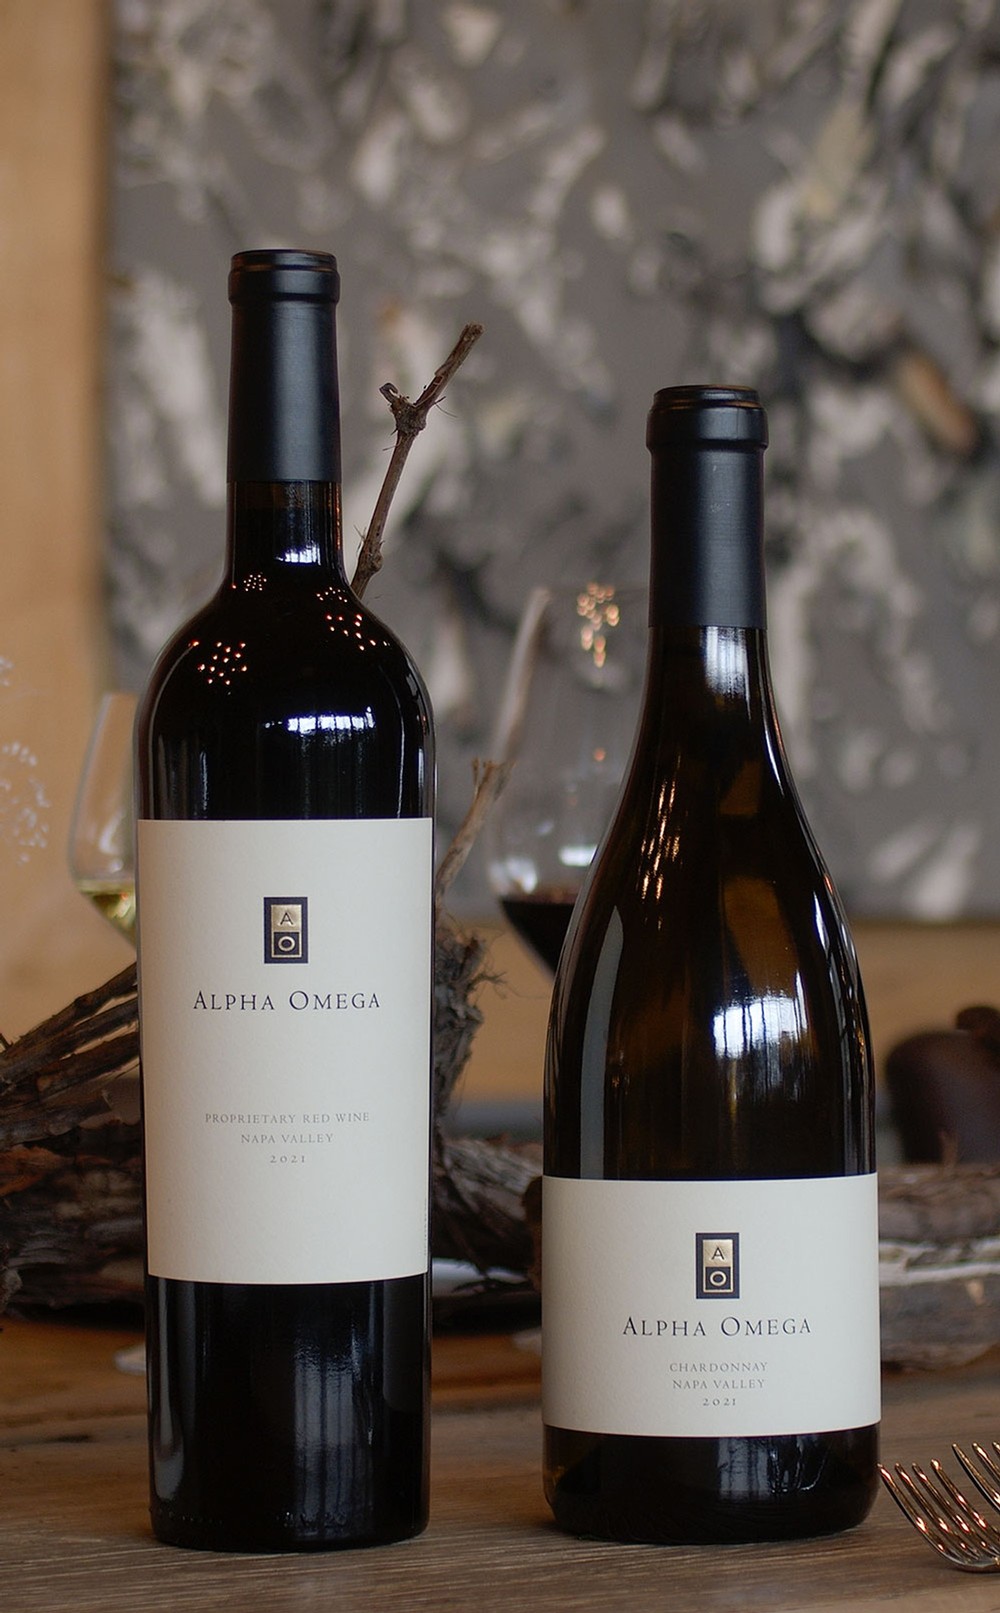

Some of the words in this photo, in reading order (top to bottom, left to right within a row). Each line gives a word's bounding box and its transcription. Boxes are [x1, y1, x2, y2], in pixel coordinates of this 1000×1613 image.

[280, 911, 294, 926] A
[278, 936, 296, 952] O
[193, 990, 275, 1011] ALPHA
[289, 990, 380, 1011] OMEGA
[205, 1112, 296, 1125] PROPRIETARY
[303, 1114, 330, 1124] RED
[336, 1112, 369, 1123] WINE
[241, 1134, 275, 1144] NAPA
[281, 1133, 334, 1144] VALLEY
[269, 1154, 306, 1164] 2021
[711, 1247, 725, 1260] A
[709, 1271, 727, 1286] O
[622, 1316, 706, 1337] ALPHA
[720, 1316, 811, 1337] OMEGA
[669, 1362, 768, 1373] CHARDONNAY
[672, 1379, 708, 1390] NAPA
[713, 1379, 765, 1390] VALLEY
[702, 1397, 737, 1407] 2021
